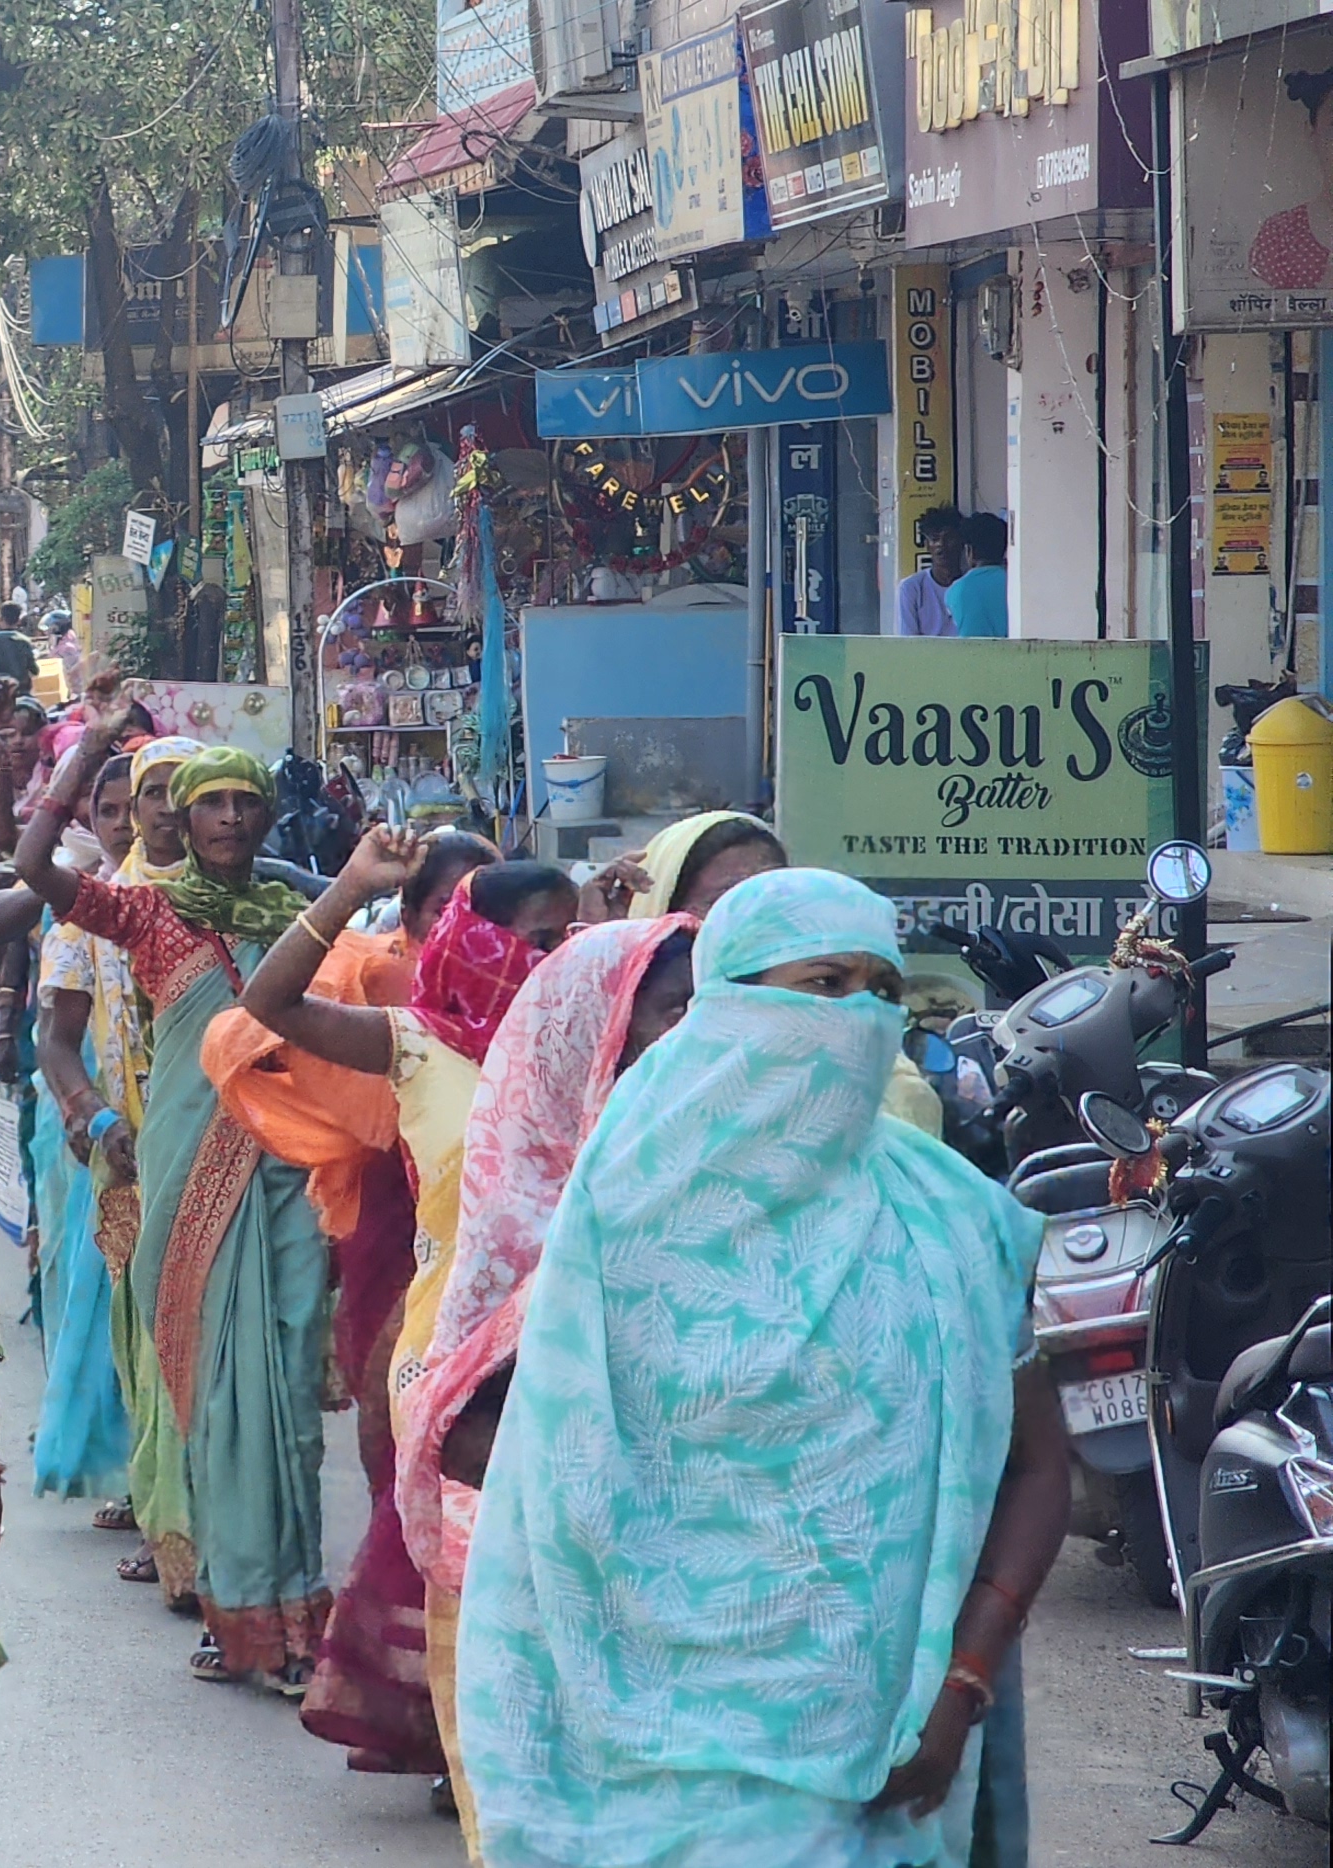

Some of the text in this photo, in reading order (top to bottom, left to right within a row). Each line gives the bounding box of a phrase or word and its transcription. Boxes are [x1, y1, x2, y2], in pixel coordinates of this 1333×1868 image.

[754, 59, 791, 155] THE
[783, 46, 823, 147] CELL
[814, 25, 869, 136] STORY
[590, 158, 633, 234] INDIAN
[627, 147, 653, 214] SAL
[575, 375, 633, 419] vi
[679, 359, 850, 410] vivo
[908, 288, 937, 482] MOBILE
[793, 672, 1112, 782] Vaasu'S
[937, 771, 1053, 828] Batter
[842, 834, 1147, 857] TASTE THE TRADITION
